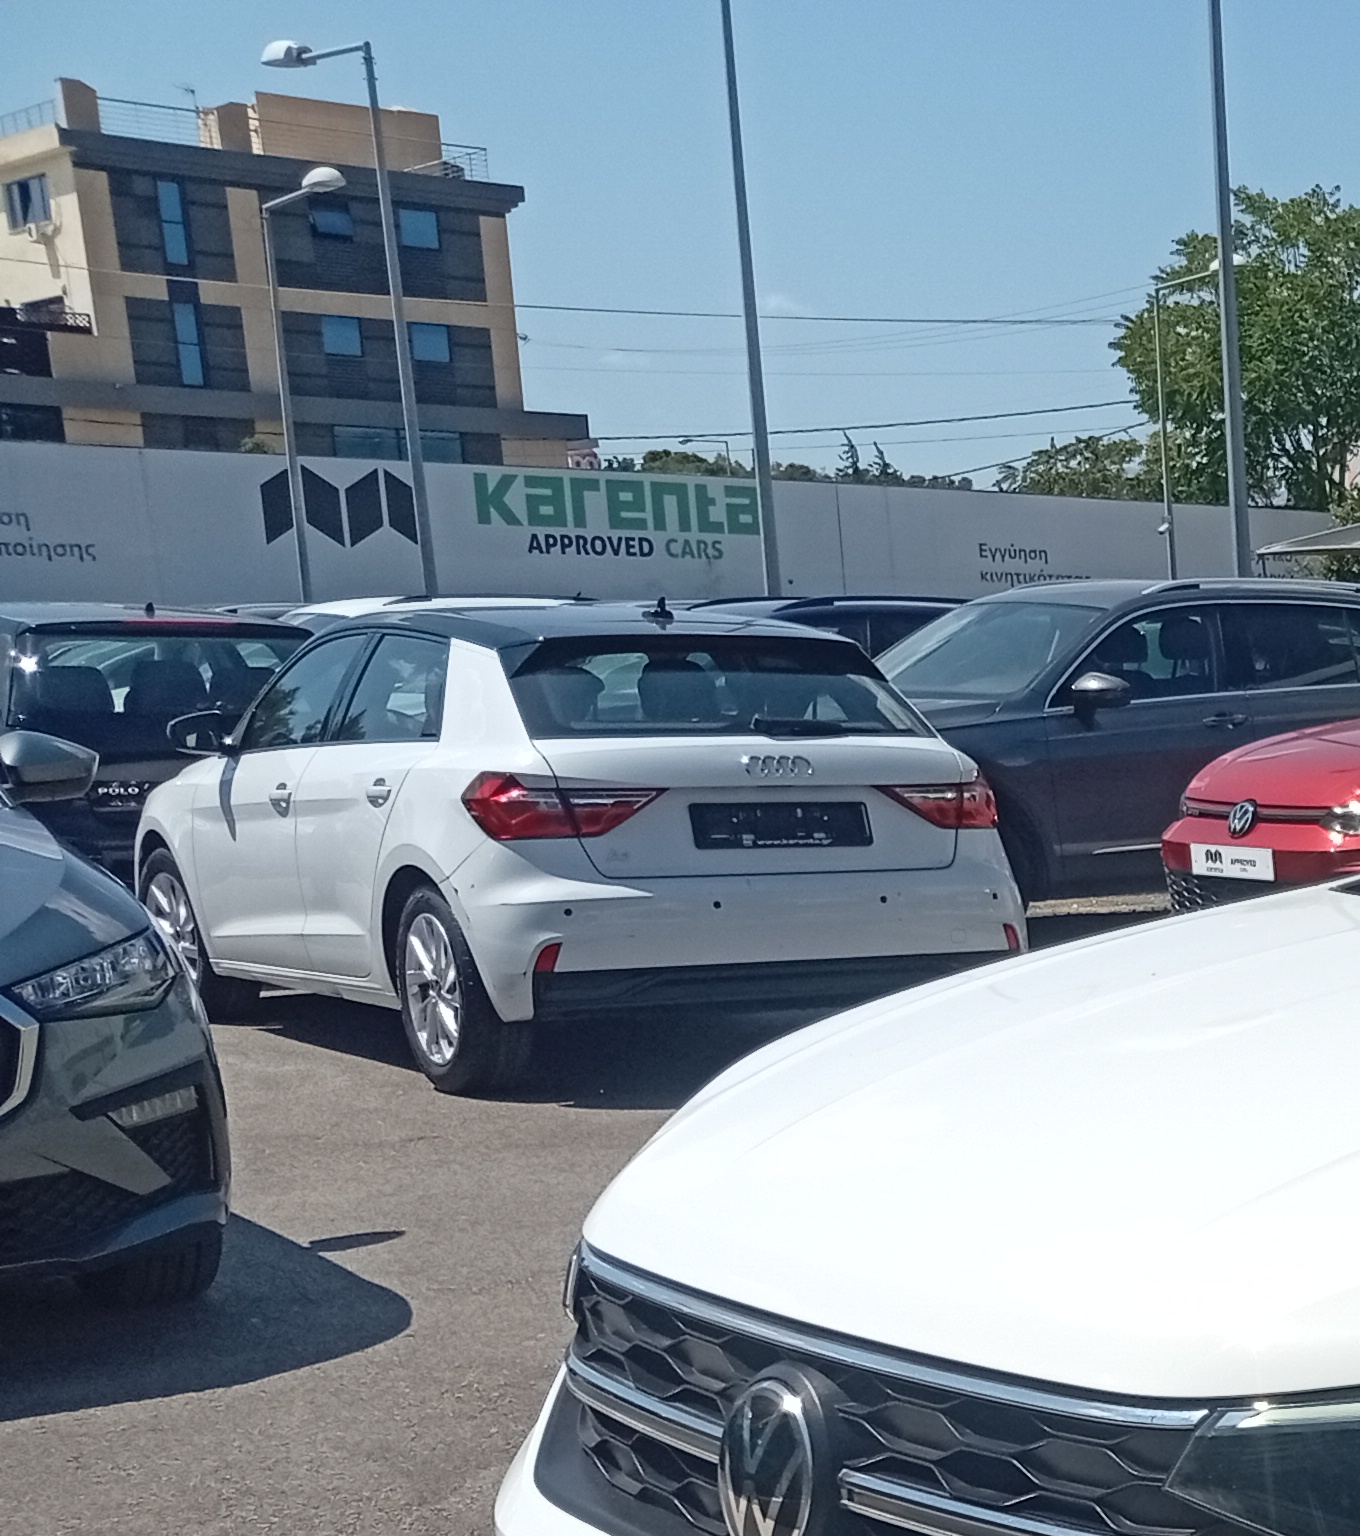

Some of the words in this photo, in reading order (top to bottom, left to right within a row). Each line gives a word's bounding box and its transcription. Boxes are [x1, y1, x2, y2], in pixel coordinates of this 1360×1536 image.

[527, 533, 655, 558] APPROVED
[665, 538, 724, 561] CARS
[977, 542, 1048, 565] Εγγύηση
[97, 786, 140, 797] POLO
